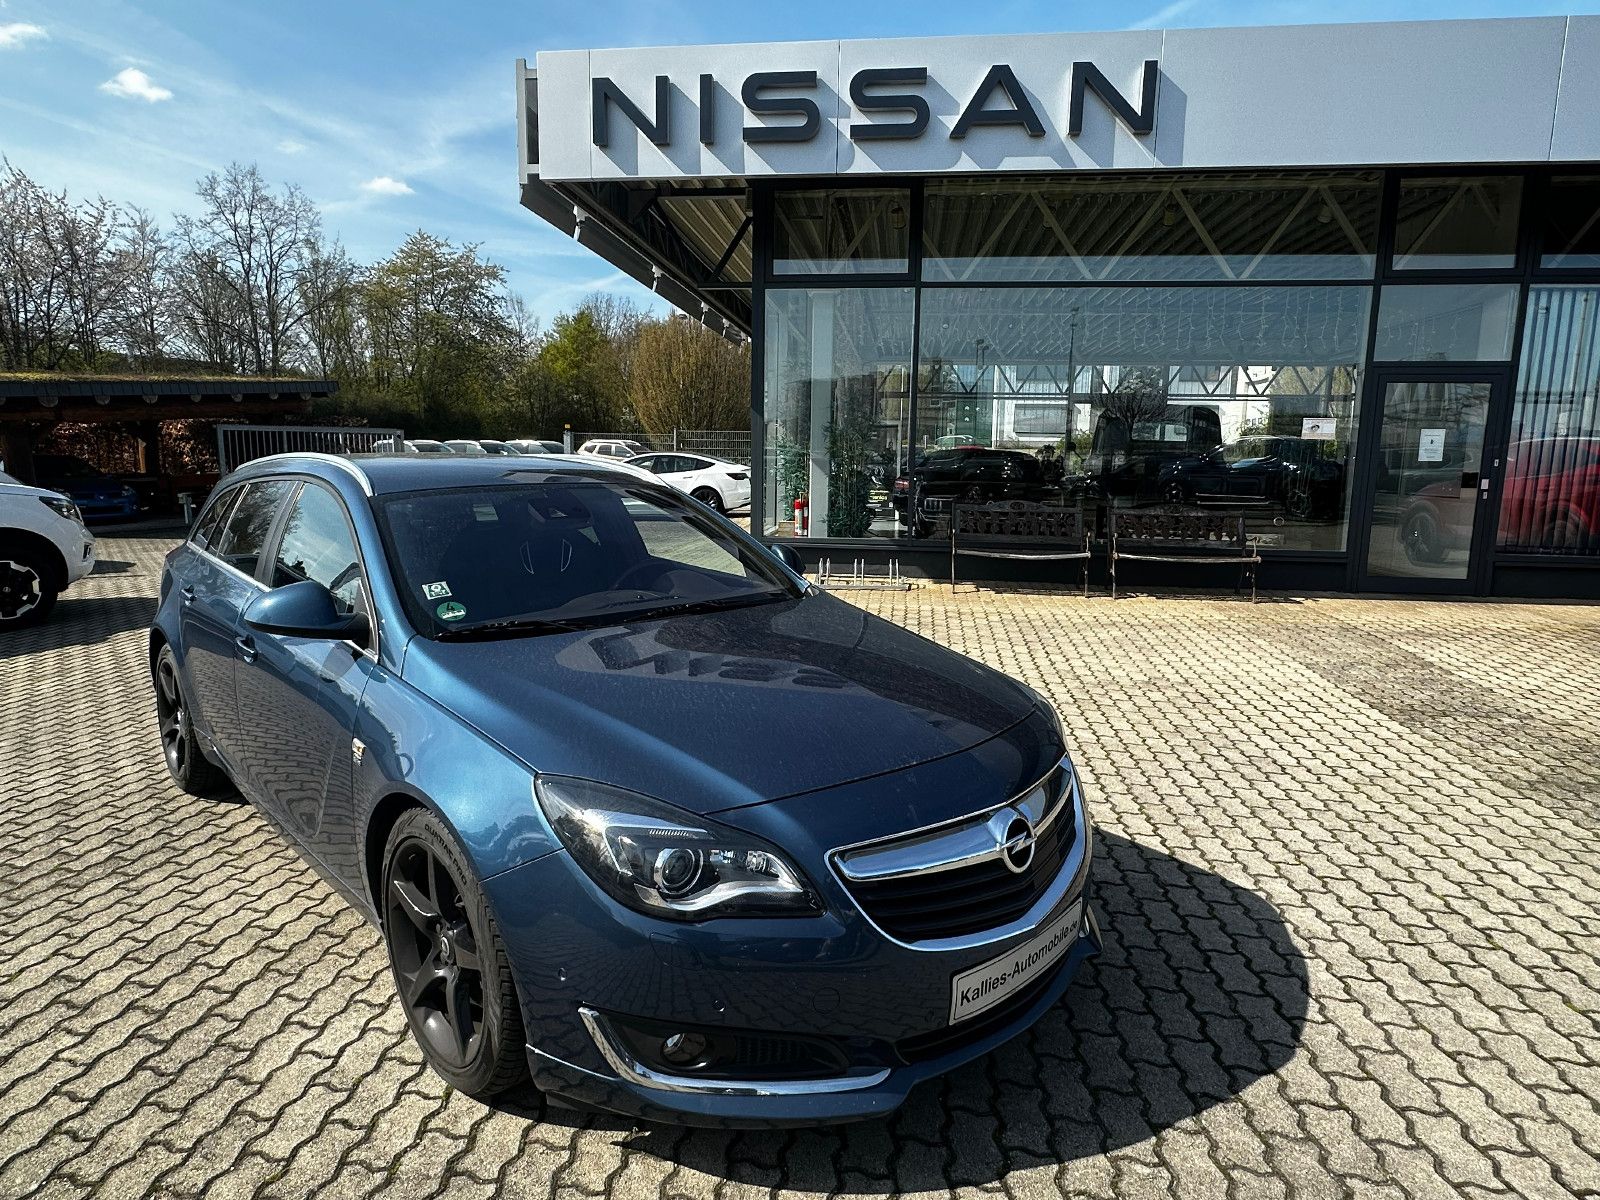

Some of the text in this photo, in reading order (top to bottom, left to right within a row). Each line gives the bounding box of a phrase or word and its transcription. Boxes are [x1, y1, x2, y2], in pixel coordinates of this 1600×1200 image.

[591, 60, 1158, 147] NISSAN
[452, 858, 467, 886] PRO
[960, 920, 1078, 1006] Kallies-Automobile.de
